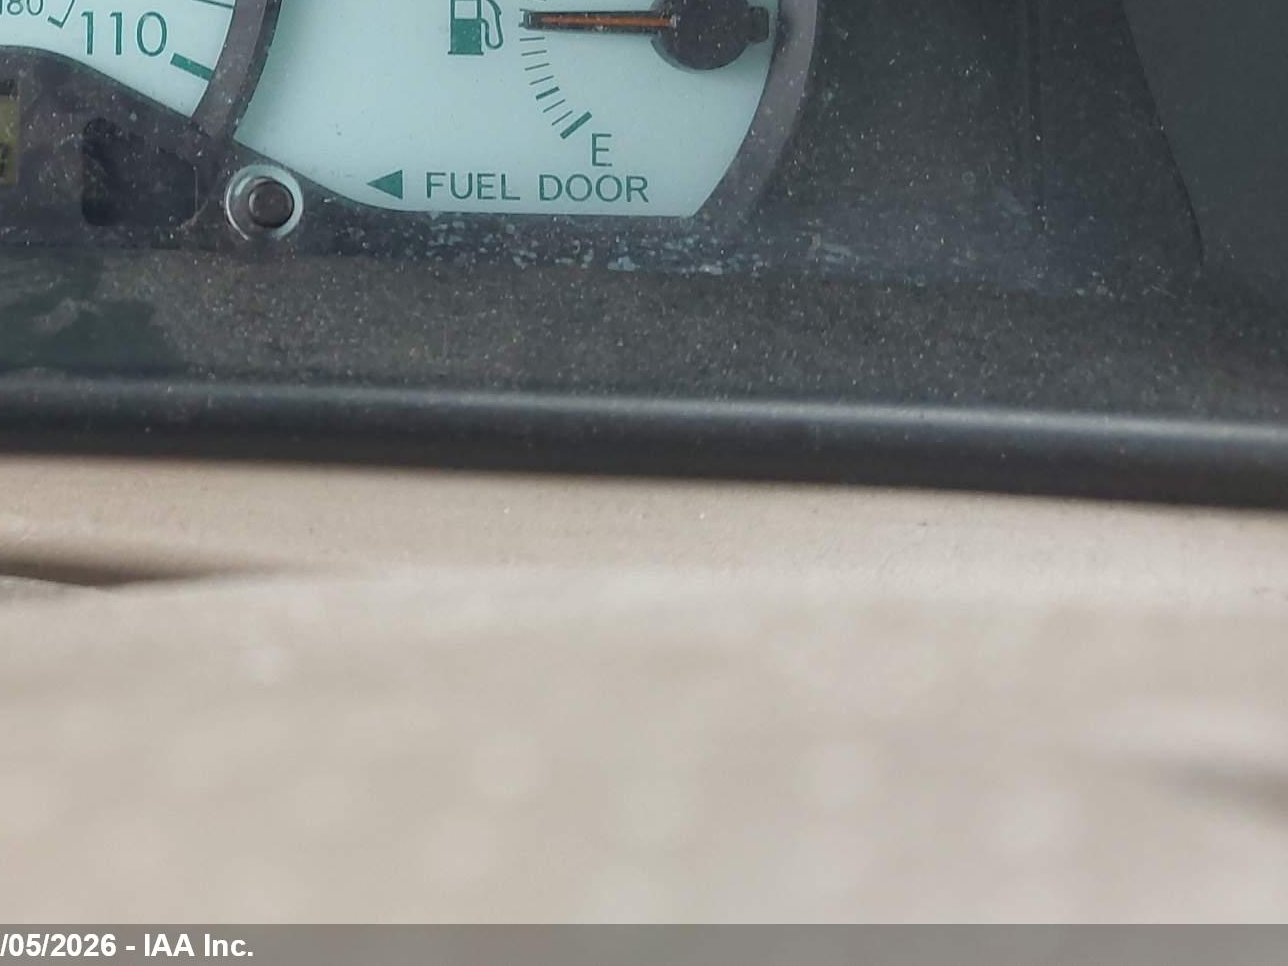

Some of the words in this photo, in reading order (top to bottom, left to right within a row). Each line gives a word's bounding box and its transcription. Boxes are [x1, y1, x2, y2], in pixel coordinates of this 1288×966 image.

[81, 11, 168, 57] 110
[592, 134, 612, 167] E
[426, 172, 520, 202] FUEL
[539, 173, 649, 203] DOOR
